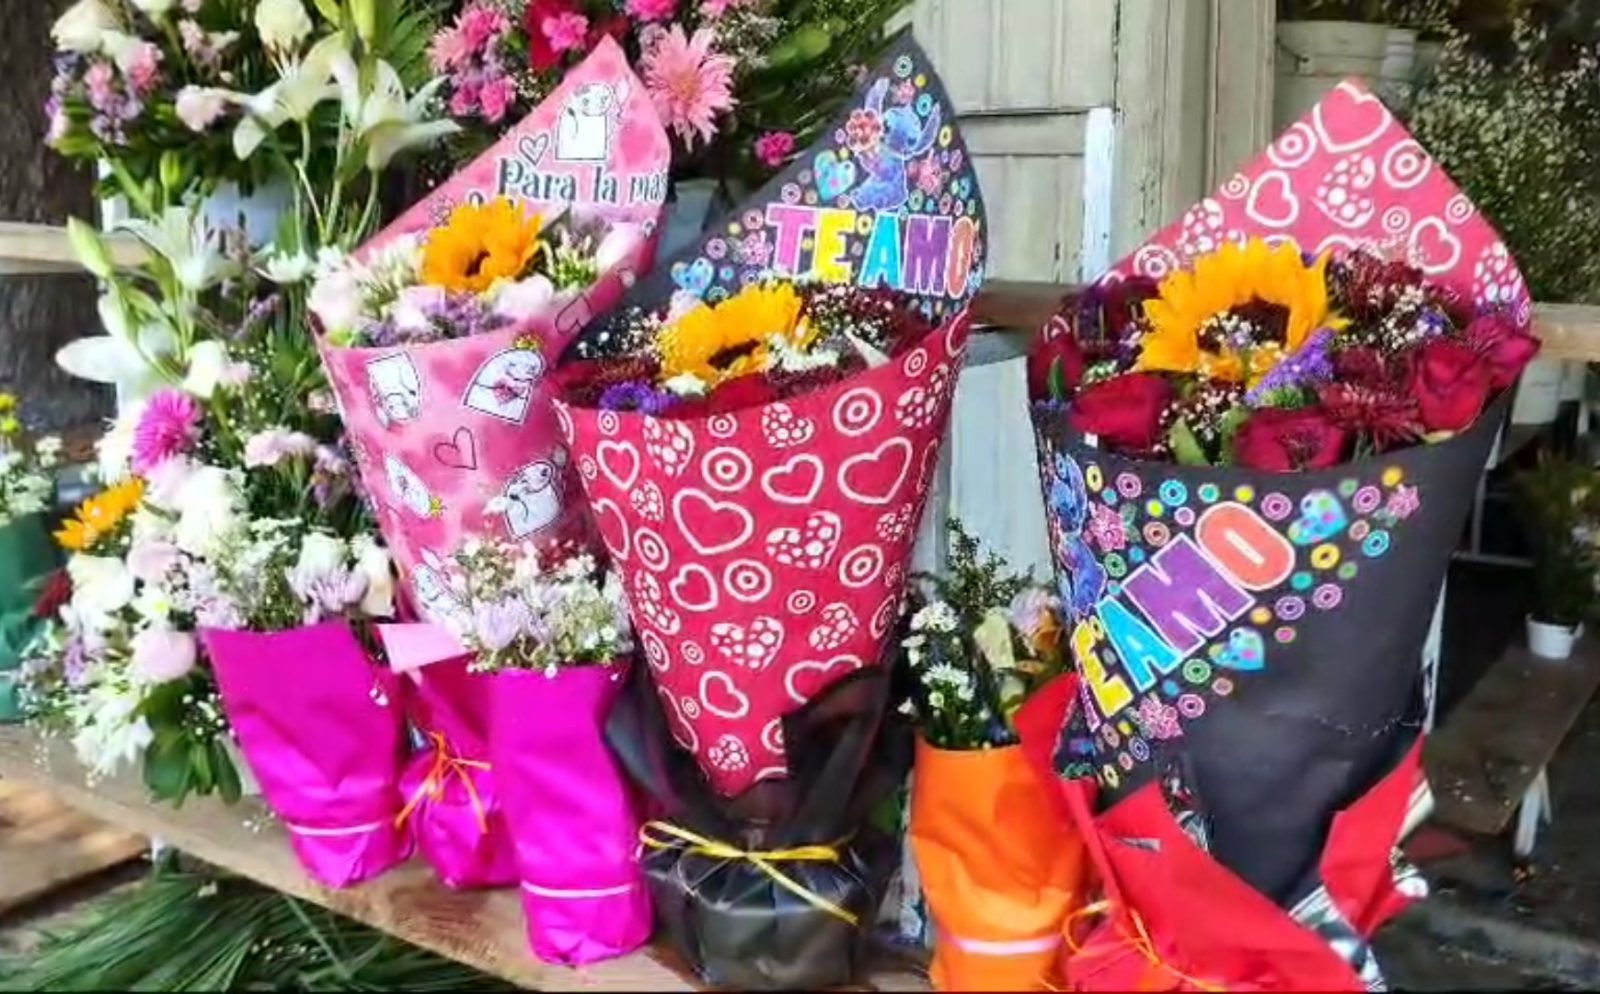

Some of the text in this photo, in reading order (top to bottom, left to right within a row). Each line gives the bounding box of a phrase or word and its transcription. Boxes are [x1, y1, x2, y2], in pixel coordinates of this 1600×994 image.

[499, 158, 577, 201] Para
[593, 165, 617, 203] la
[765, 203, 976, 299] TE AMO
[1095, 500, 1296, 693] AMO
